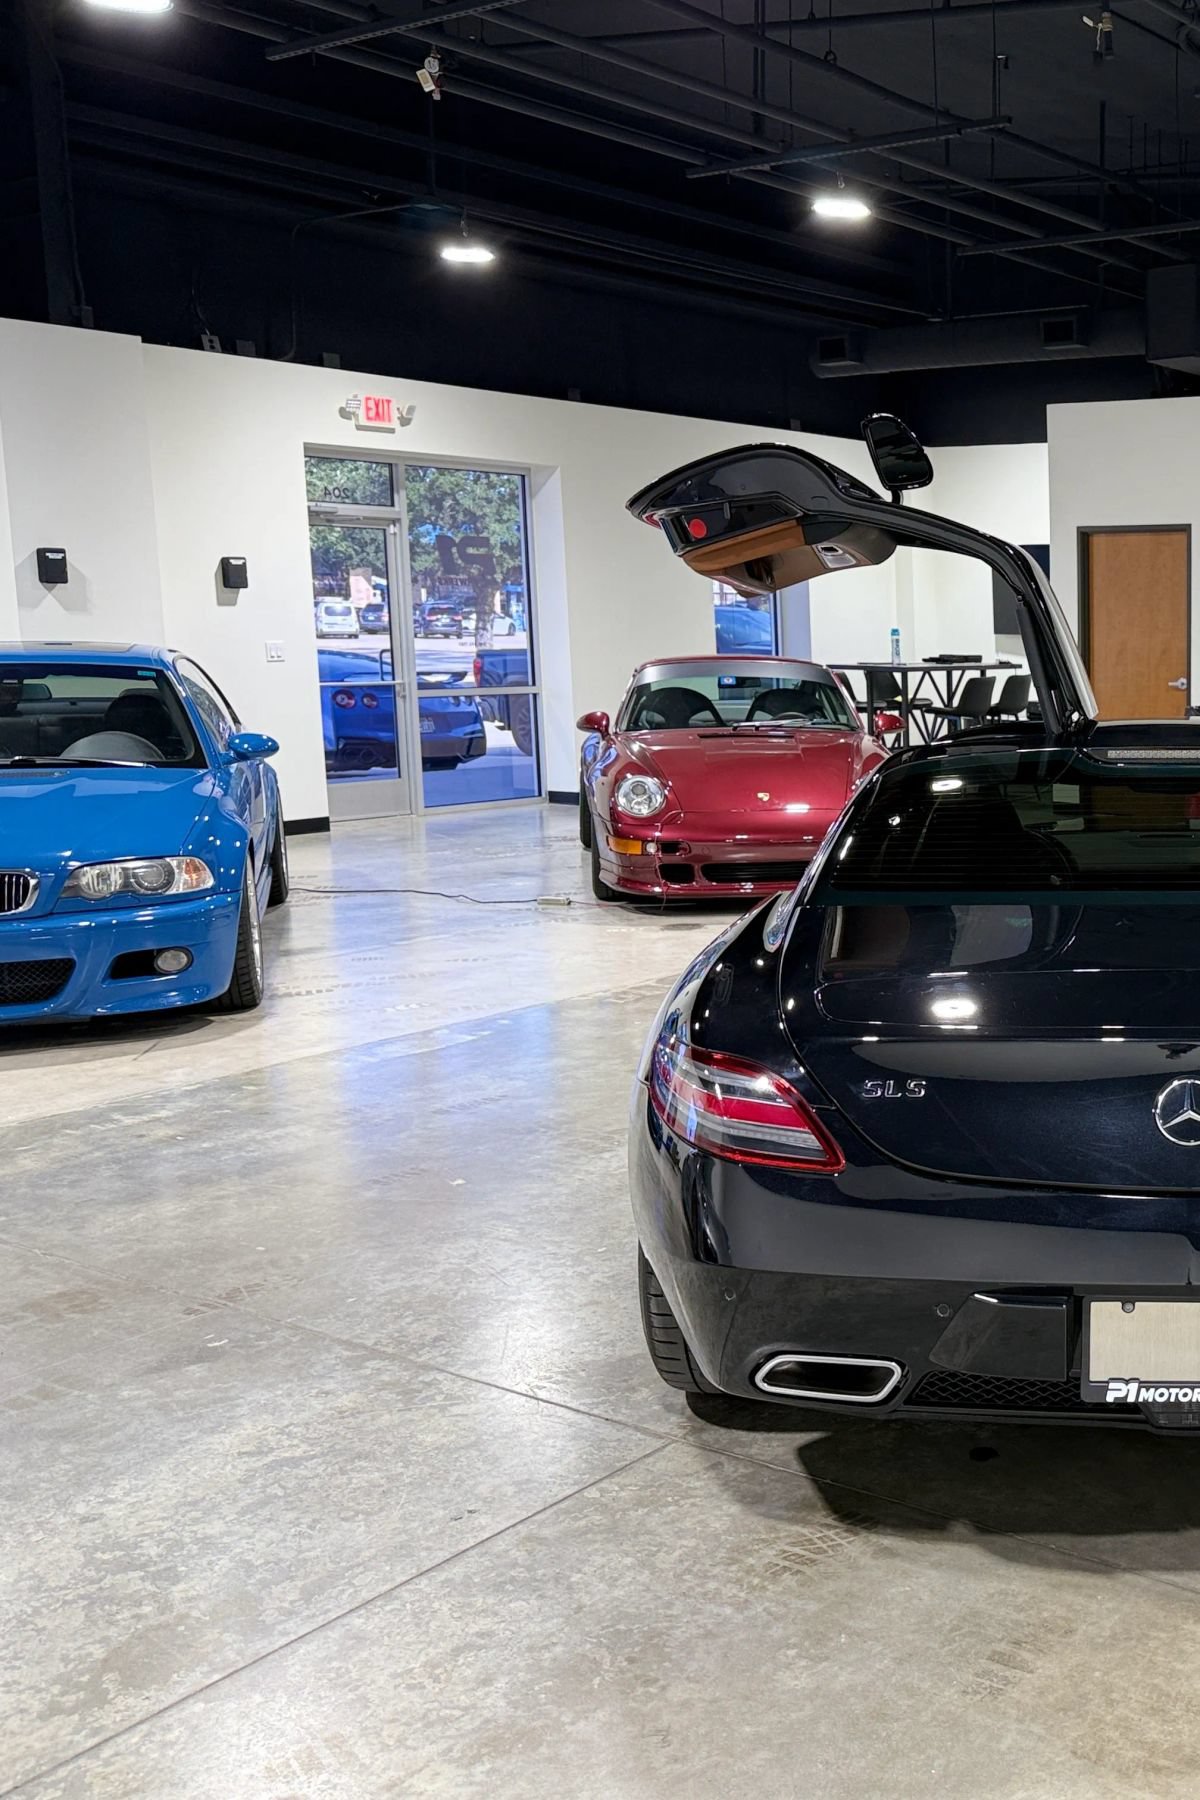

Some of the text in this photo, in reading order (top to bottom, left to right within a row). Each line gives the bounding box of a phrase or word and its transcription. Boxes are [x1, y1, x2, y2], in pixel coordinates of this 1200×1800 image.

[364, 396, 392, 423] EXIT
[862, 1079, 927, 1098] SLS
[1106, 1382, 1140, 1403] P1
